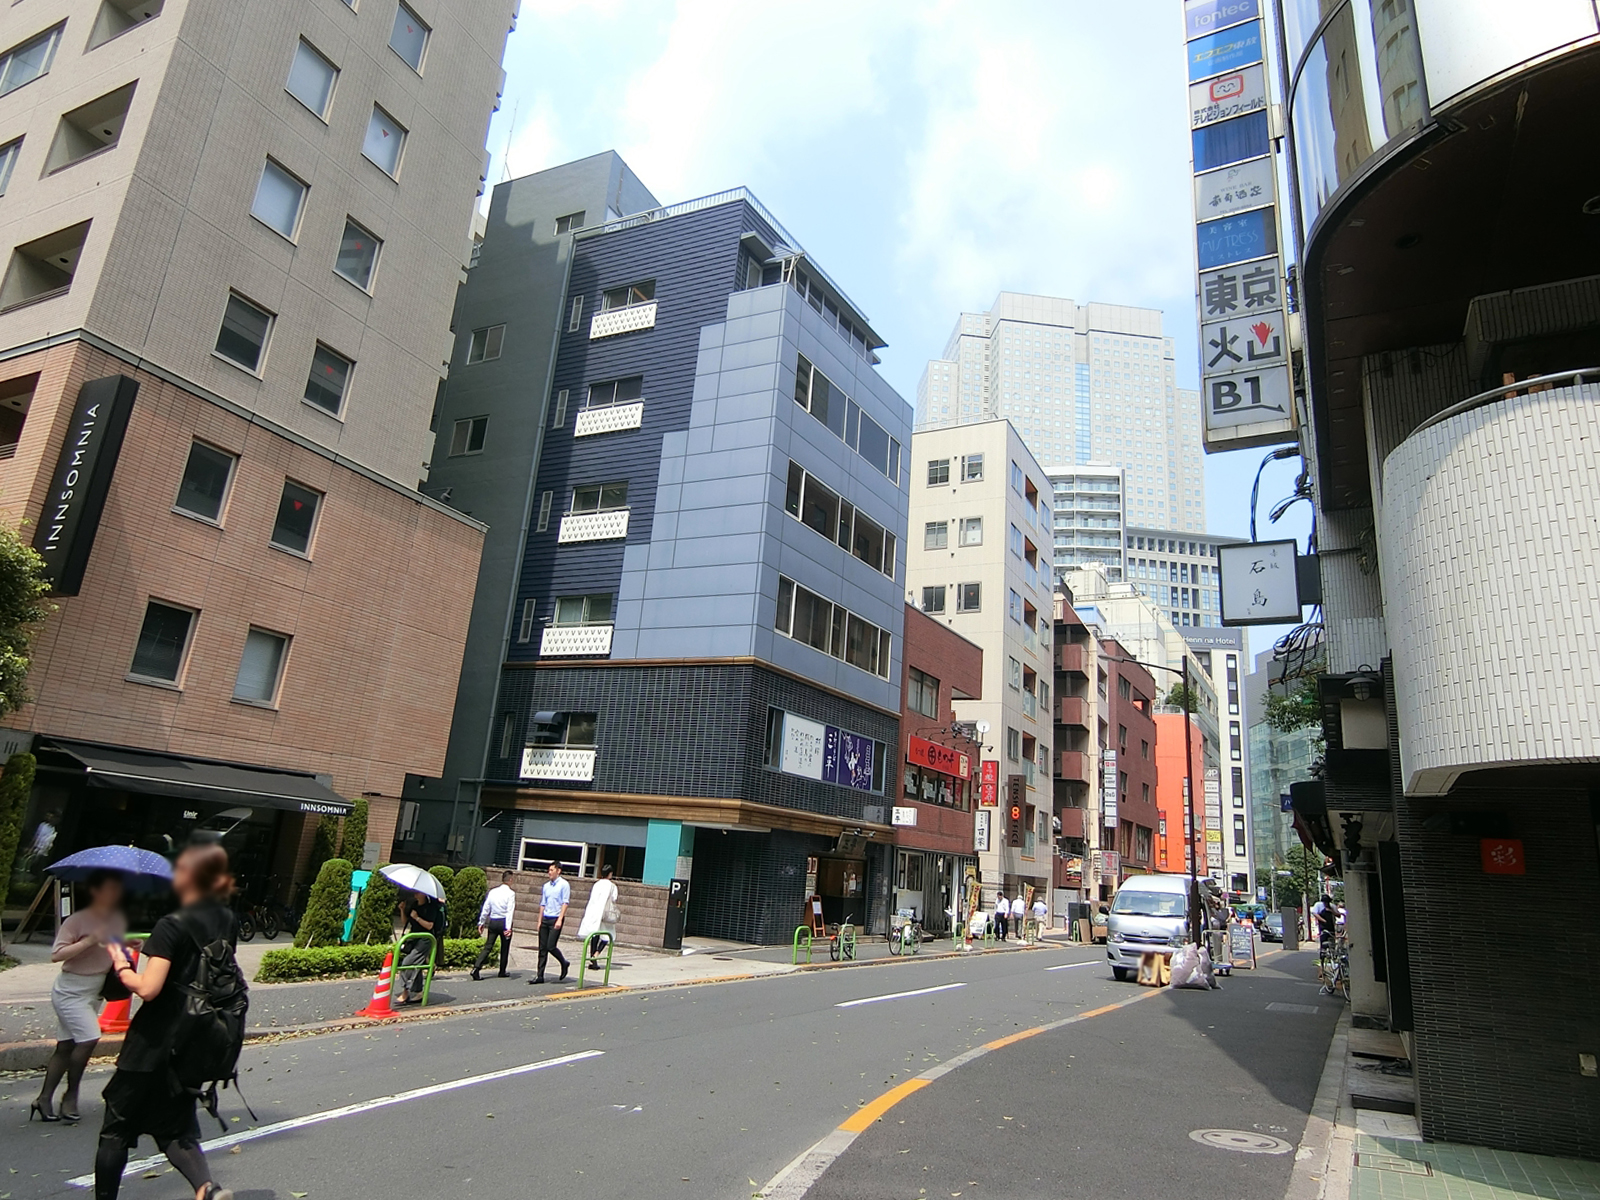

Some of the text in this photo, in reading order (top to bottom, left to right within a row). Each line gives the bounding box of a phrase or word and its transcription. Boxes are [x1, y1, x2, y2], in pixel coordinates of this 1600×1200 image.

[1194, 1, 1250, 28] tontec
[1194, 96, 1264, 126] テレビジョンフィールド
[1209, 218, 1248, 235] 美容室
[1200, 230, 1259, 254] MISTRESS
[1210, 247, 1252, 262] ミストレス
[1205, 266, 1277, 315] 東京
[1208, 321, 1281, 368] 火山
[1212, 375, 1262, 410] B1
[45, 403, 100, 550] INNSOMNIA
[1183, 635, 1203, 643] Henn
[1215, 637, 1236, 646] Hotel
[300, 802, 347, 815] INNSOMNIA
[671, 882, 681, 895] P
